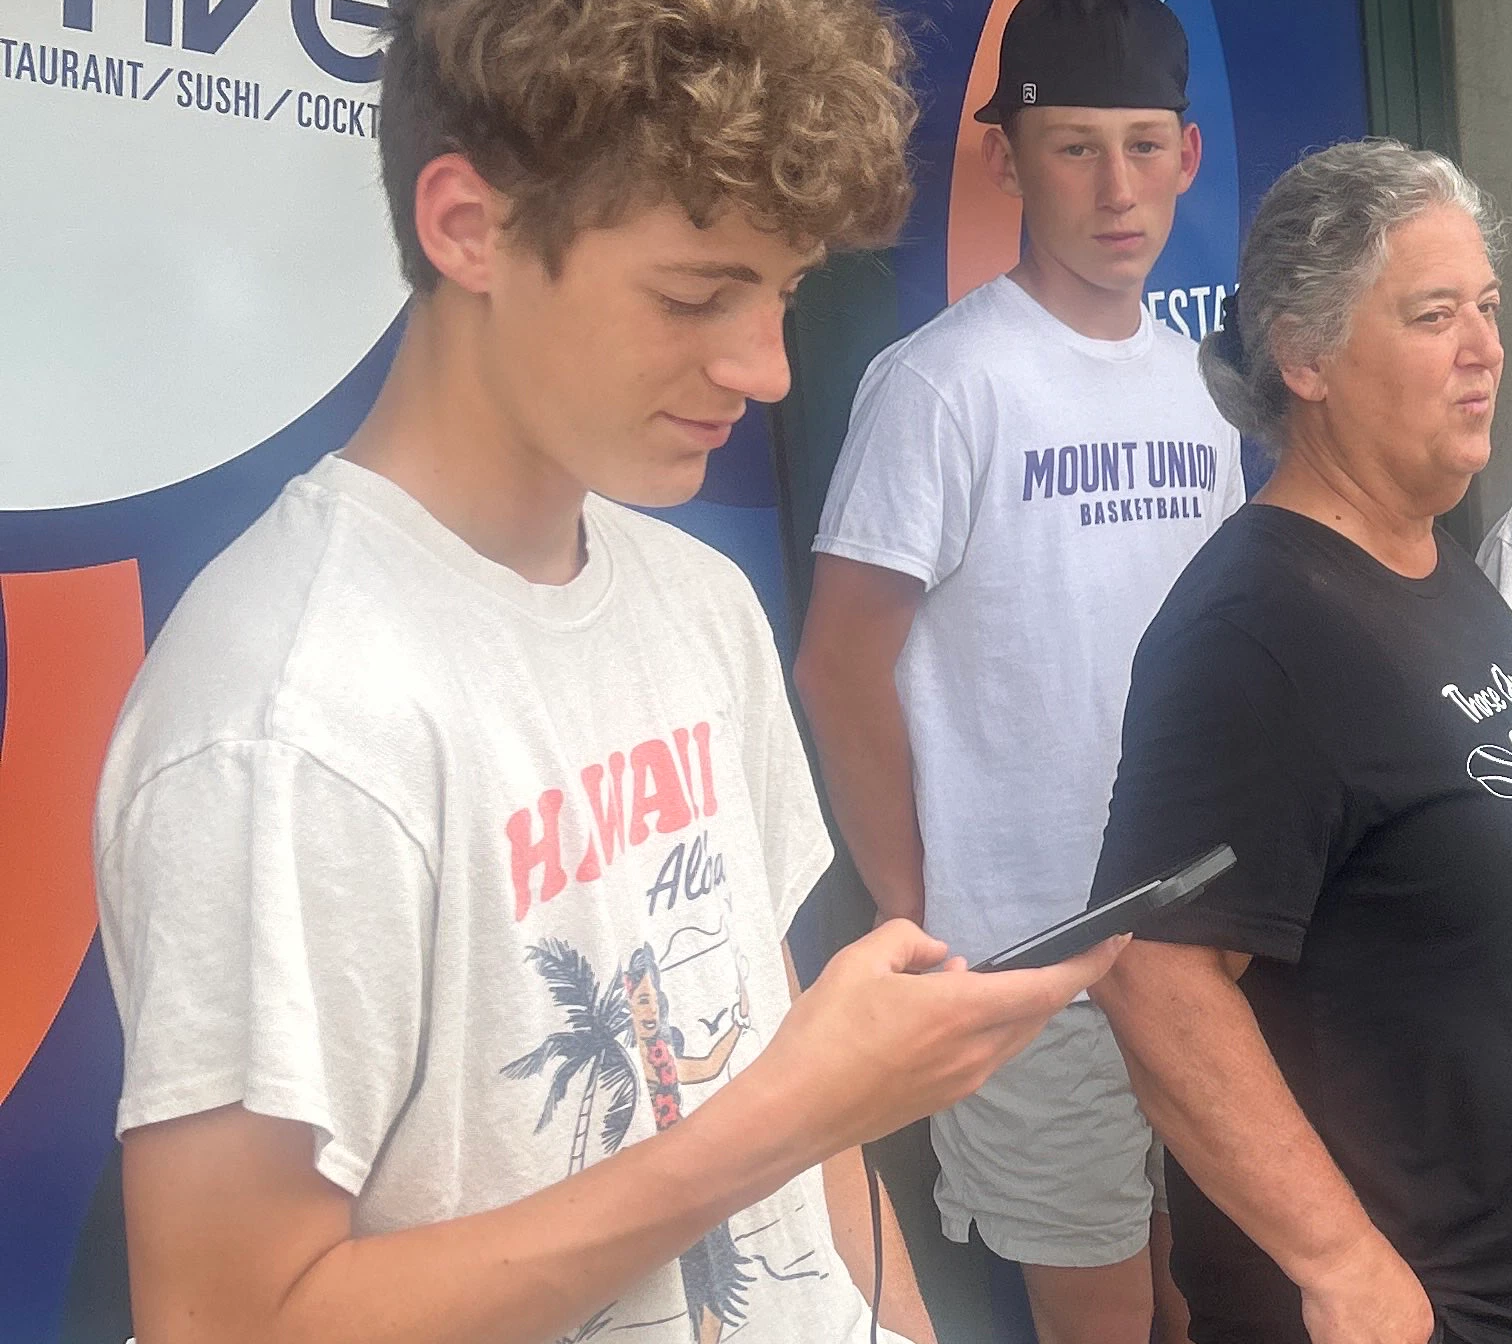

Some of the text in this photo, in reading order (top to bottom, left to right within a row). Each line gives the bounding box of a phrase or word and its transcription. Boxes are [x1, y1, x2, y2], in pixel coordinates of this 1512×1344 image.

[1022, 438, 1218, 502] MOUNT UNION
[1080, 496, 1202, 527] BASKETBALL
[1442, 683, 1507, 723] Those
[506, 721, 718, 923] HWAII
